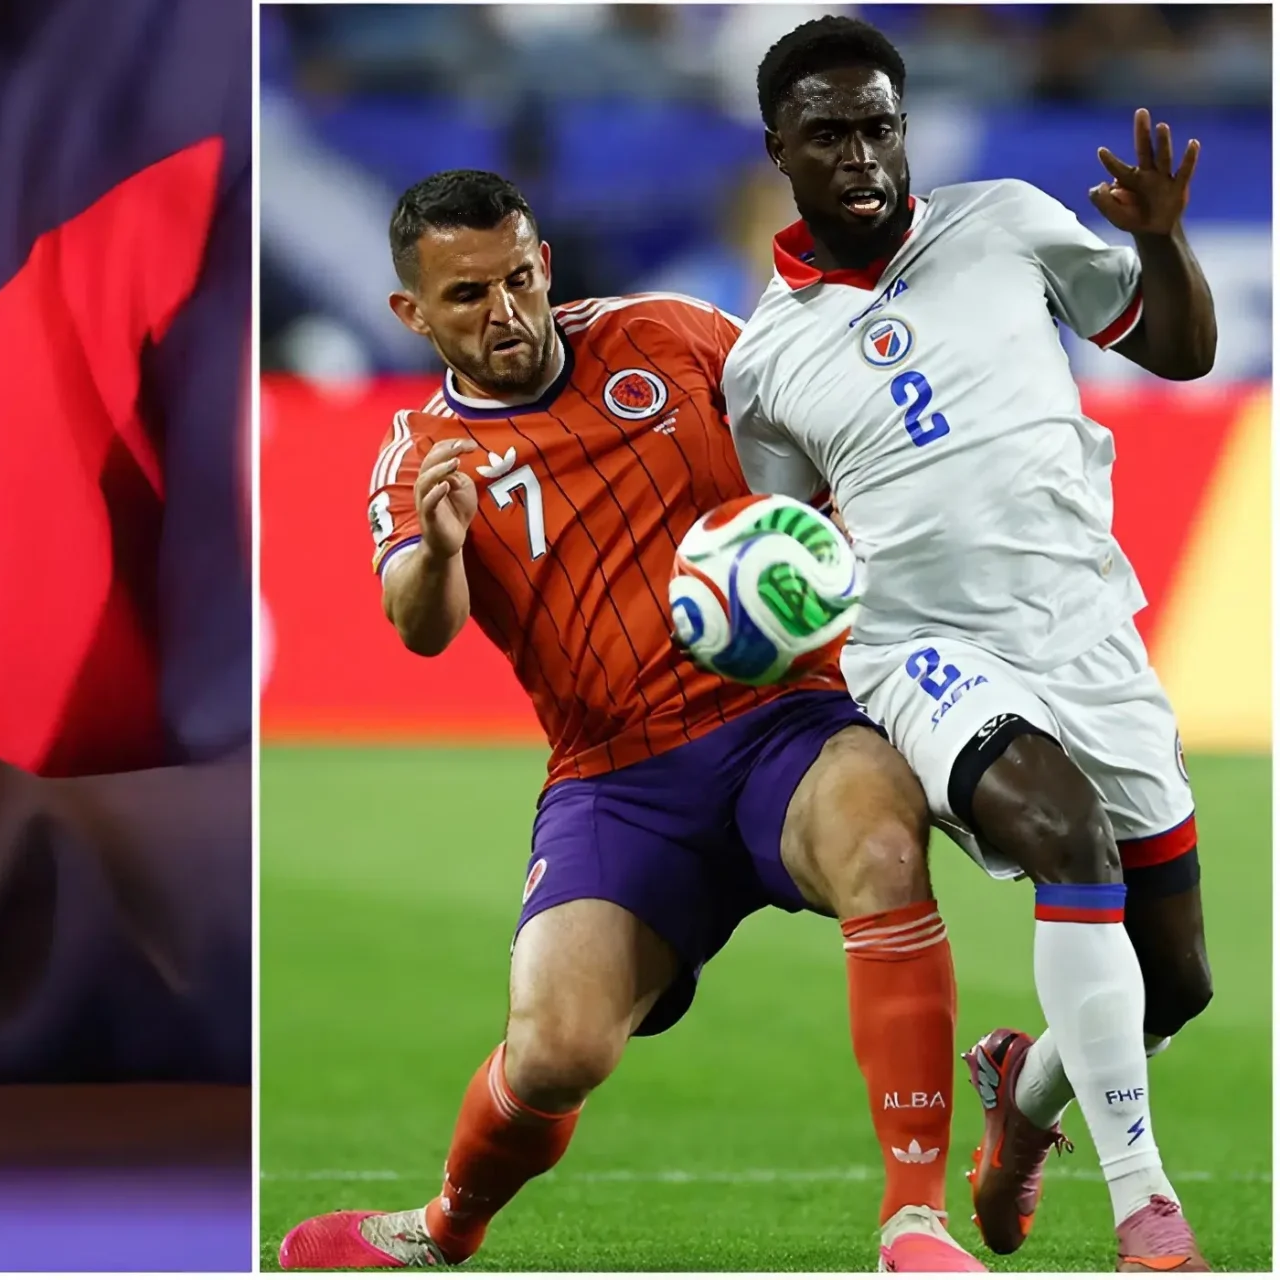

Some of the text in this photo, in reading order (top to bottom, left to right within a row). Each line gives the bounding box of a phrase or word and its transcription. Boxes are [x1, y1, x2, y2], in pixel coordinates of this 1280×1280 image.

[890, 370, 951, 448] 2
[487, 464, 547, 562] 7
[905, 646, 962, 702] 2
[883, 1089, 946, 1111] ALBA
[1105, 1087, 1144, 1106] FHF
